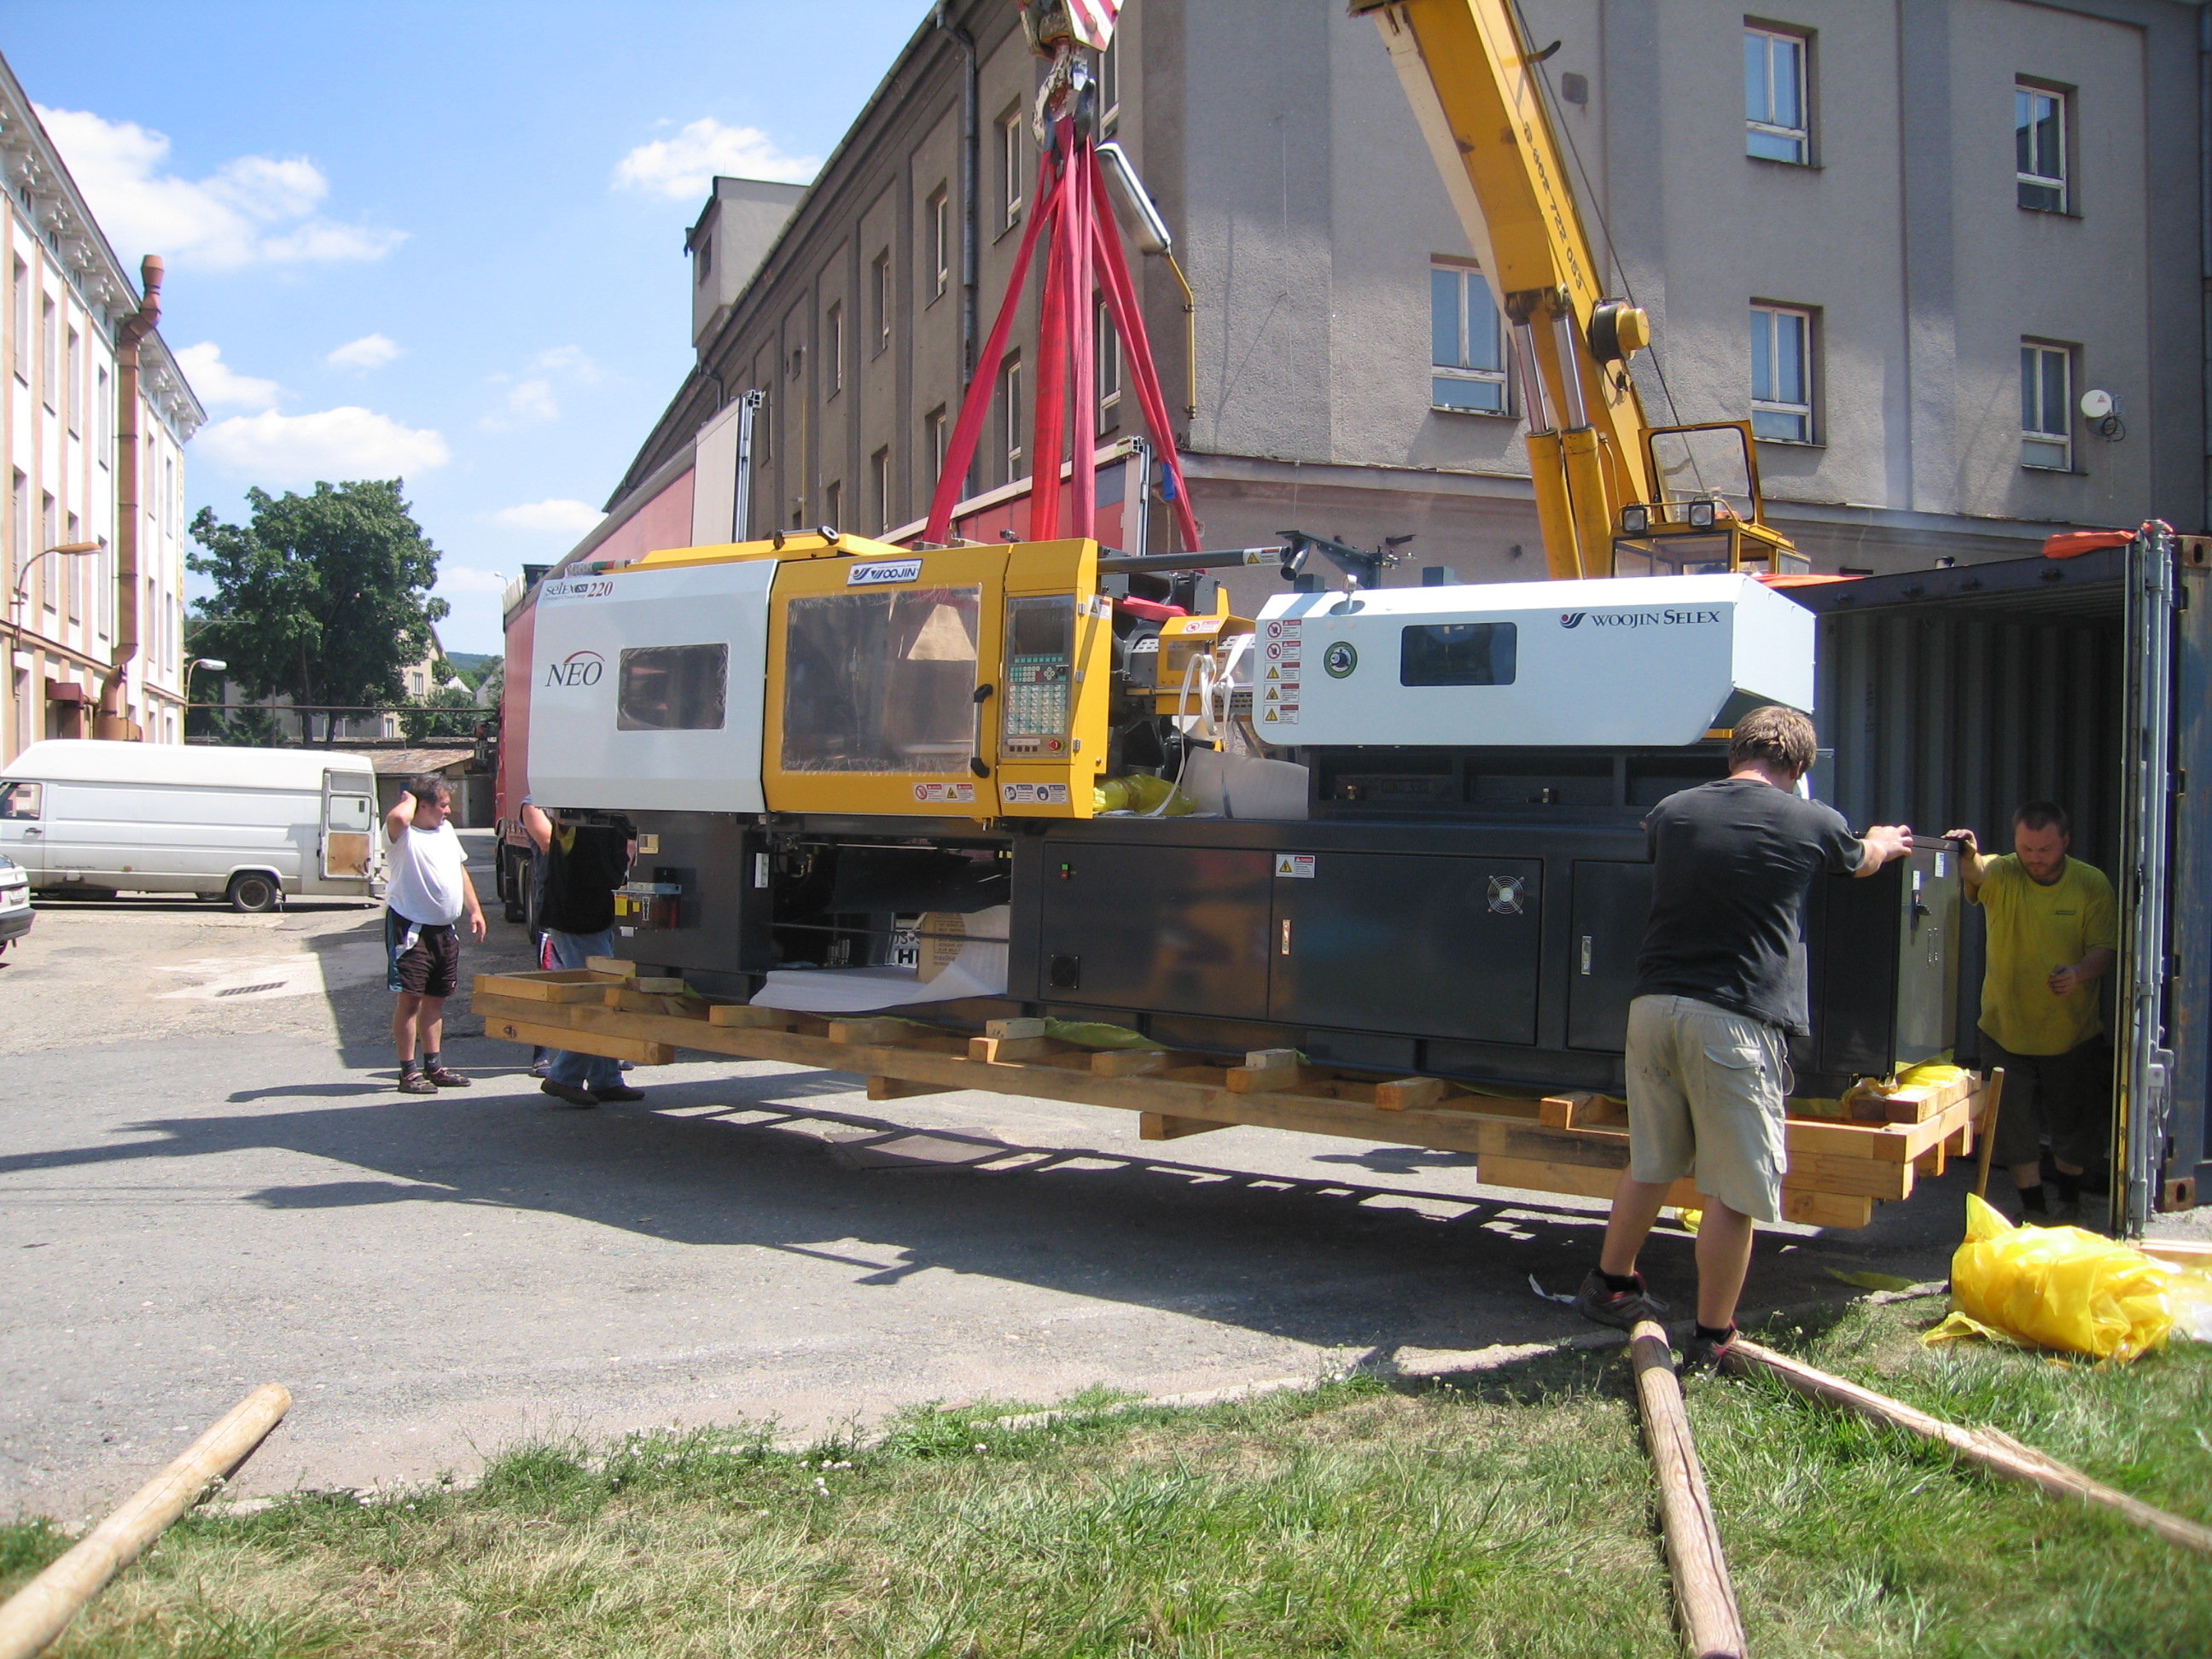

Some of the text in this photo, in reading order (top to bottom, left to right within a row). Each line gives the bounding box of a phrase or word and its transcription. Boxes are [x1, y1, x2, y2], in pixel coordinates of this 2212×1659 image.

[871, 568, 917, 579] WOOJIN
[587, 581, 613, 597] 220
[1592, 609, 1720, 628] WOOJIN SELEX
[544, 661, 602, 687] NEO
